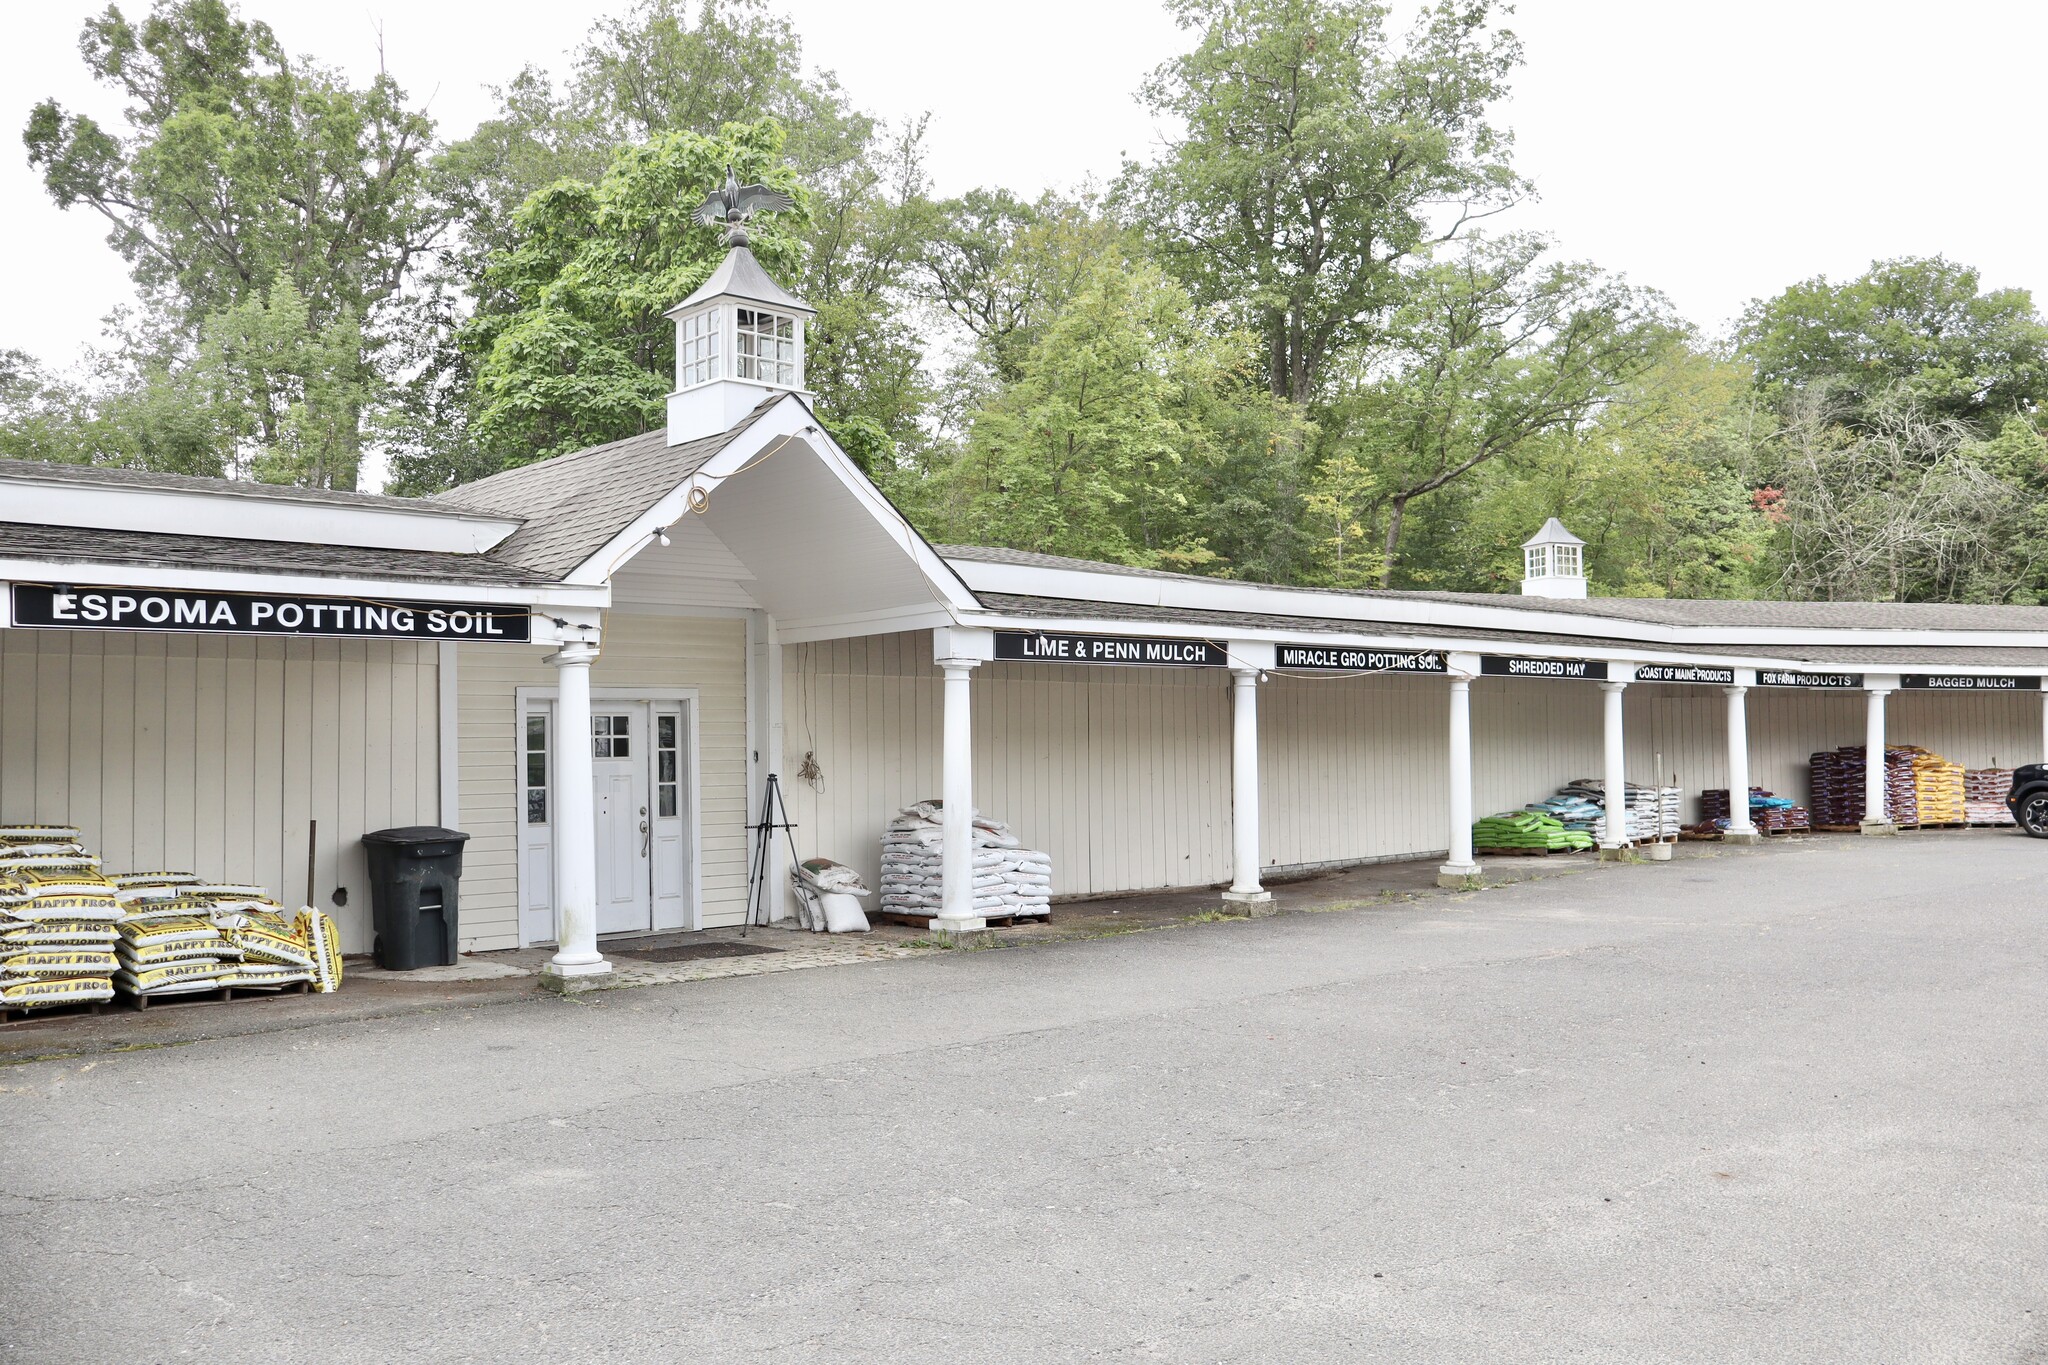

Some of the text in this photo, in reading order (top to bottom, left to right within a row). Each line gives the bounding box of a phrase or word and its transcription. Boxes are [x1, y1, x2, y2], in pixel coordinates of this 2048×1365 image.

[53, 594, 503, 635] ESPOMA POTTING SOIL
[1023, 639, 1206, 662] LIME & PENN MULCH
[1283, 649, 1338, 666] MIRACLE
[1340, 652, 1365, 667] GRO
[1368, 653, 1416, 669] POTTING
[1509, 660, 1586, 676] SHREDDED HAY
[1639, 667, 1732, 683] COAST OF MAINE PRODUCTS
[1763, 672, 1852, 686] FOX FARM PRODUCTS
[1928, 678, 2015, 687] BAGGED MULCH
[32, 898, 78, 909] HAPPY
[81, 898, 117, 907] FROG
[76, 923, 112, 932] FROG
[164, 940, 206, 952] HAPPY
[274, 941, 306, 958] FROG
[27, 955, 73, 965] HAPPY
[76, 955, 112, 964] FROG
[165, 964, 207, 976] HAPPY
[25, 981, 109, 995] HAPPY FROG
